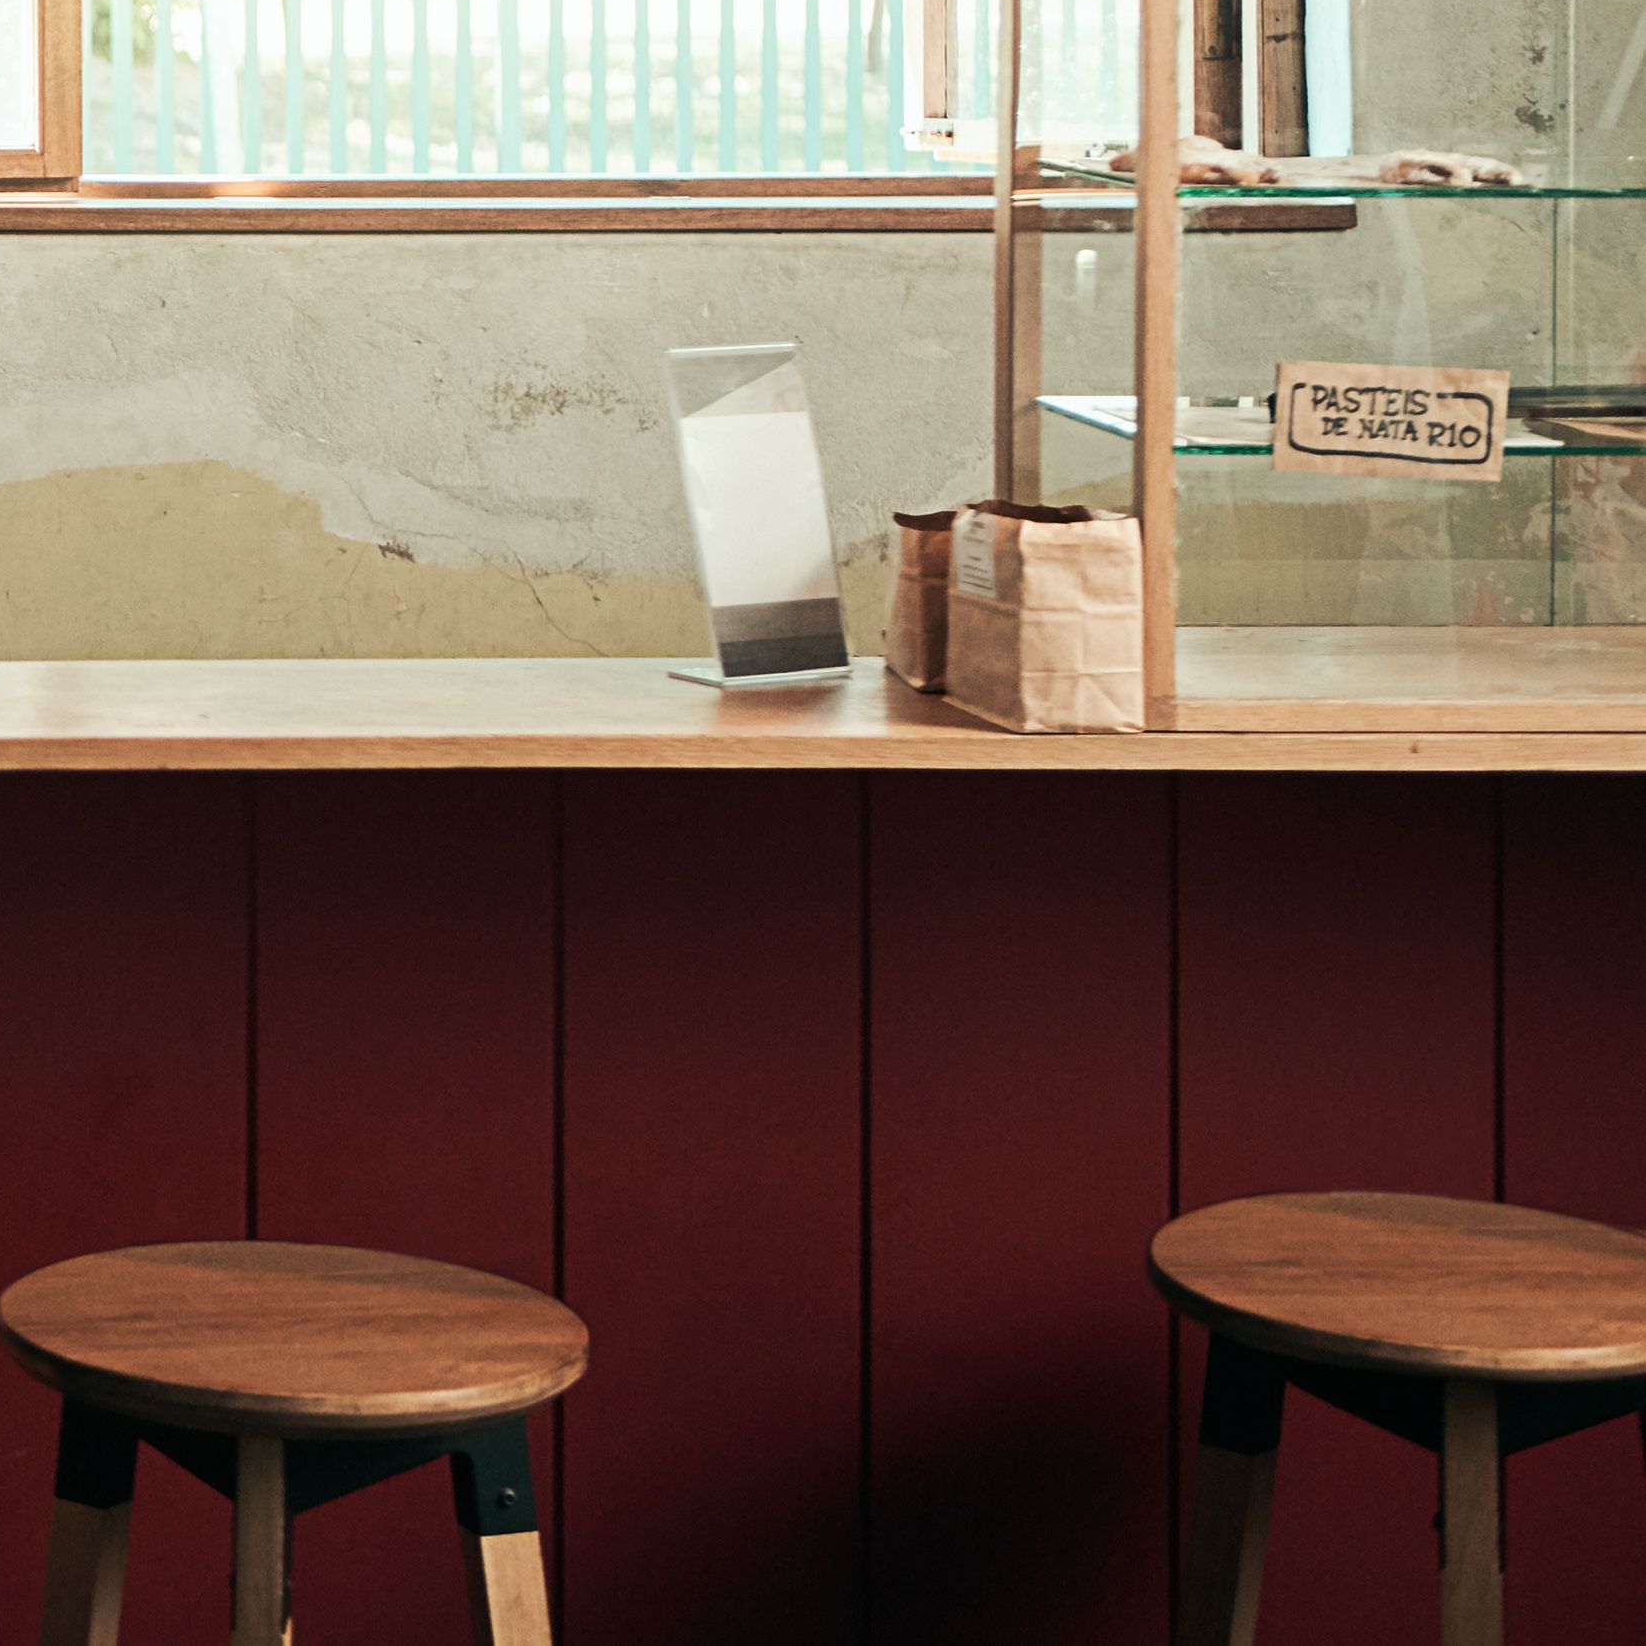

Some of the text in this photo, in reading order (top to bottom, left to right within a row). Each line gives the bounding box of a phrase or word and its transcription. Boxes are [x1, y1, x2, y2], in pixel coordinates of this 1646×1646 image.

[1310, 384, 1431, 417] PASTEIS
[1321, 416, 1482, 448] DE NATA R10
